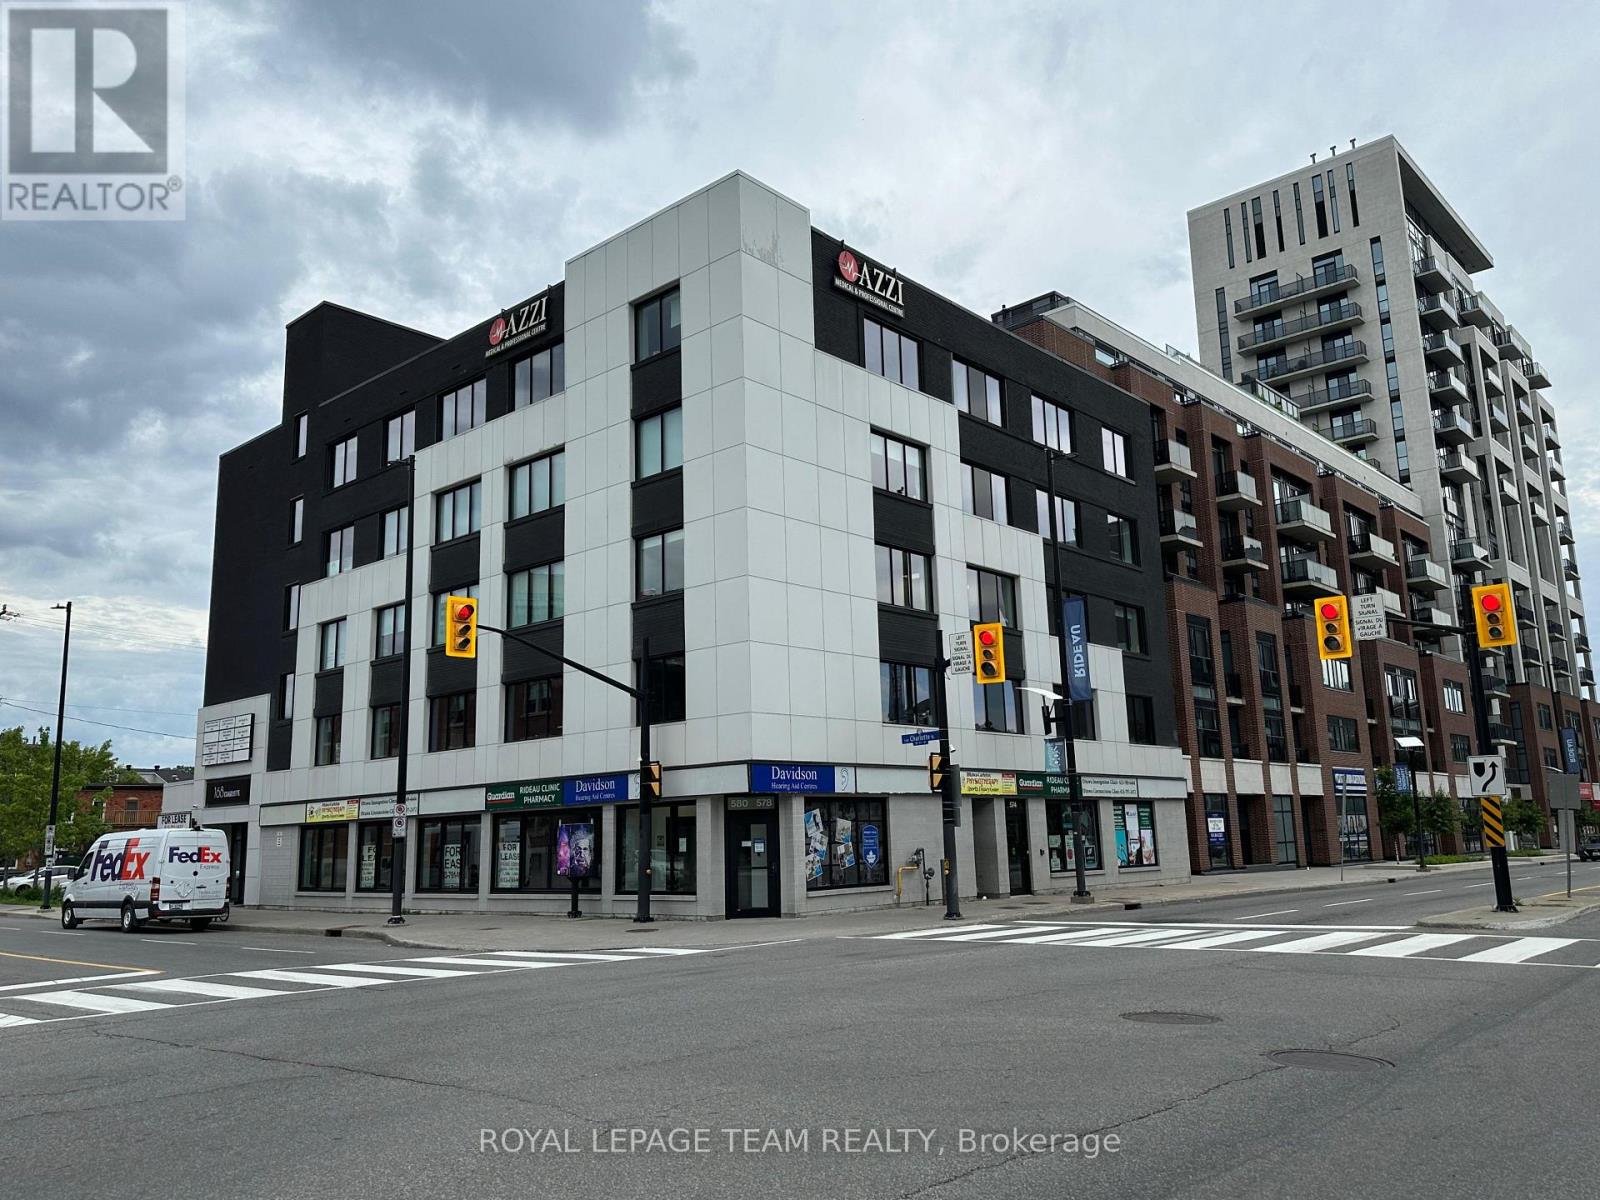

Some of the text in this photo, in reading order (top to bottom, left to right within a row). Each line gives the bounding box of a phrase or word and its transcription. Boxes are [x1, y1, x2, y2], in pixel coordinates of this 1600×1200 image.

[859, 261, 904, 306] AZZI
[834, 276, 854, 294] MEDICAL
[858, 289, 888, 310] PROFESSIONAL
[503, 296, 548, 339] AZZI
[504, 331, 531, 349] PROFESSIONAL
[771, 766, 817, 780] Davidson
[575, 778, 615, 793] Davidson
[1047, 776, 1063, 784] RIDEAU
[519, 783, 560, 794] RIDEAU CLINIC
[771, 782, 790, 790] Hearing
[1050, 786, 1070, 794] PHARMA
[487, 791, 515, 801] Guardian
[523, 794, 555, 804] PHARMACY
[730, 799, 772, 808] 580 578
[161, 814, 186, 825] FOR LEASE
[445, 846, 461, 857] FOR
[503, 843, 517, 851] FOR
[91, 838, 150, 881] FedEx
[168, 846, 222, 863] FedEx
